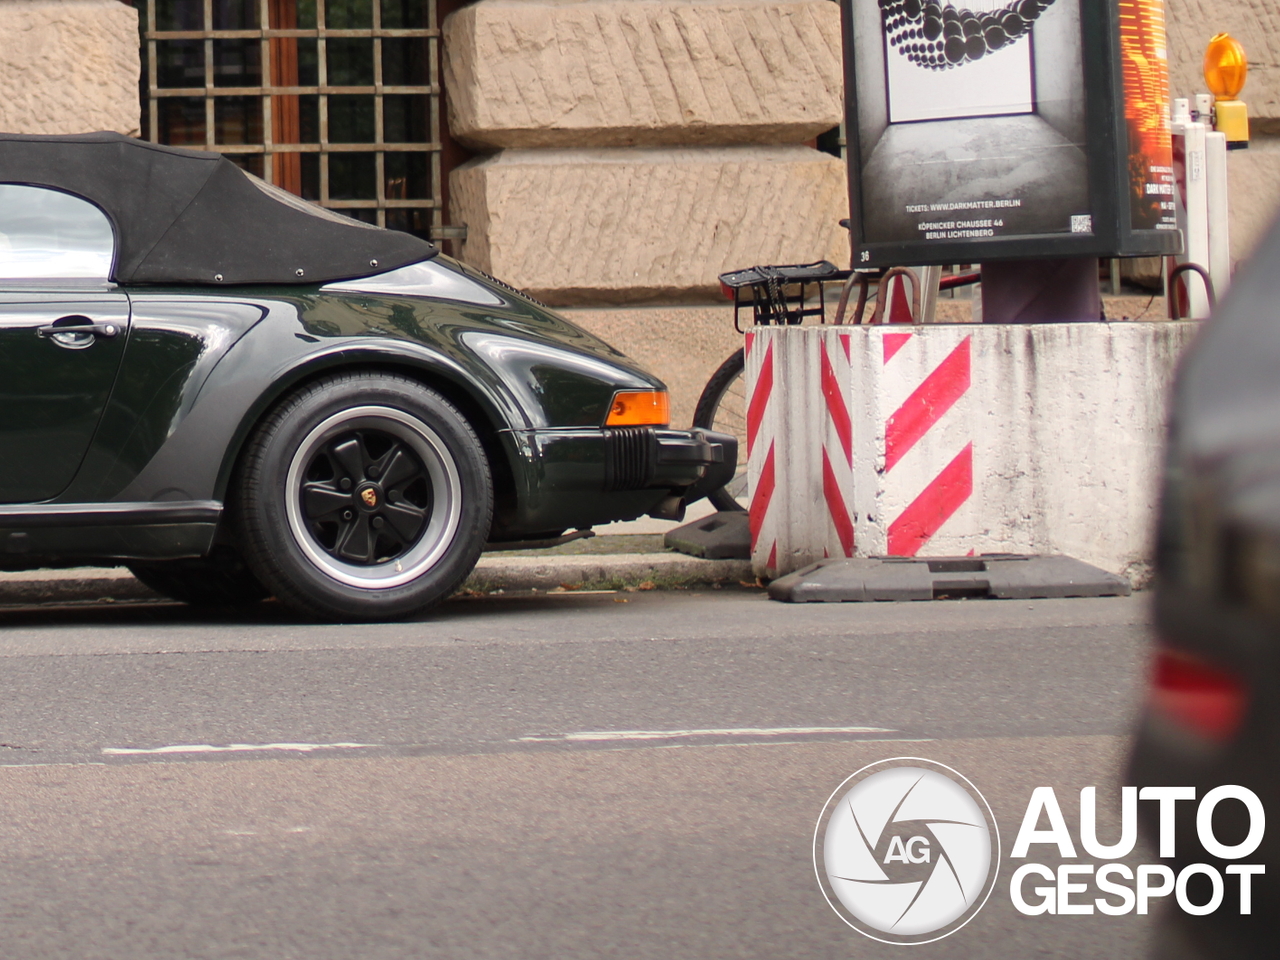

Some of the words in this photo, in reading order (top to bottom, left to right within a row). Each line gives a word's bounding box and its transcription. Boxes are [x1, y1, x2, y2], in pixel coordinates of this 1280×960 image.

[906, 204, 929, 213] TICKETS:
[930, 199, 1021, 212] WWW.DARKMATTER.BERLIN
[918, 220, 955, 231] KÖPENICKER
[956, 219, 992, 228] CHAUSSEE
[993, 218, 1003, 227] 46
[925, 231, 947, 240] BERLIN
[947, 228, 994, 239] LICHTENBERG
[860, 250, 870, 263] 36
